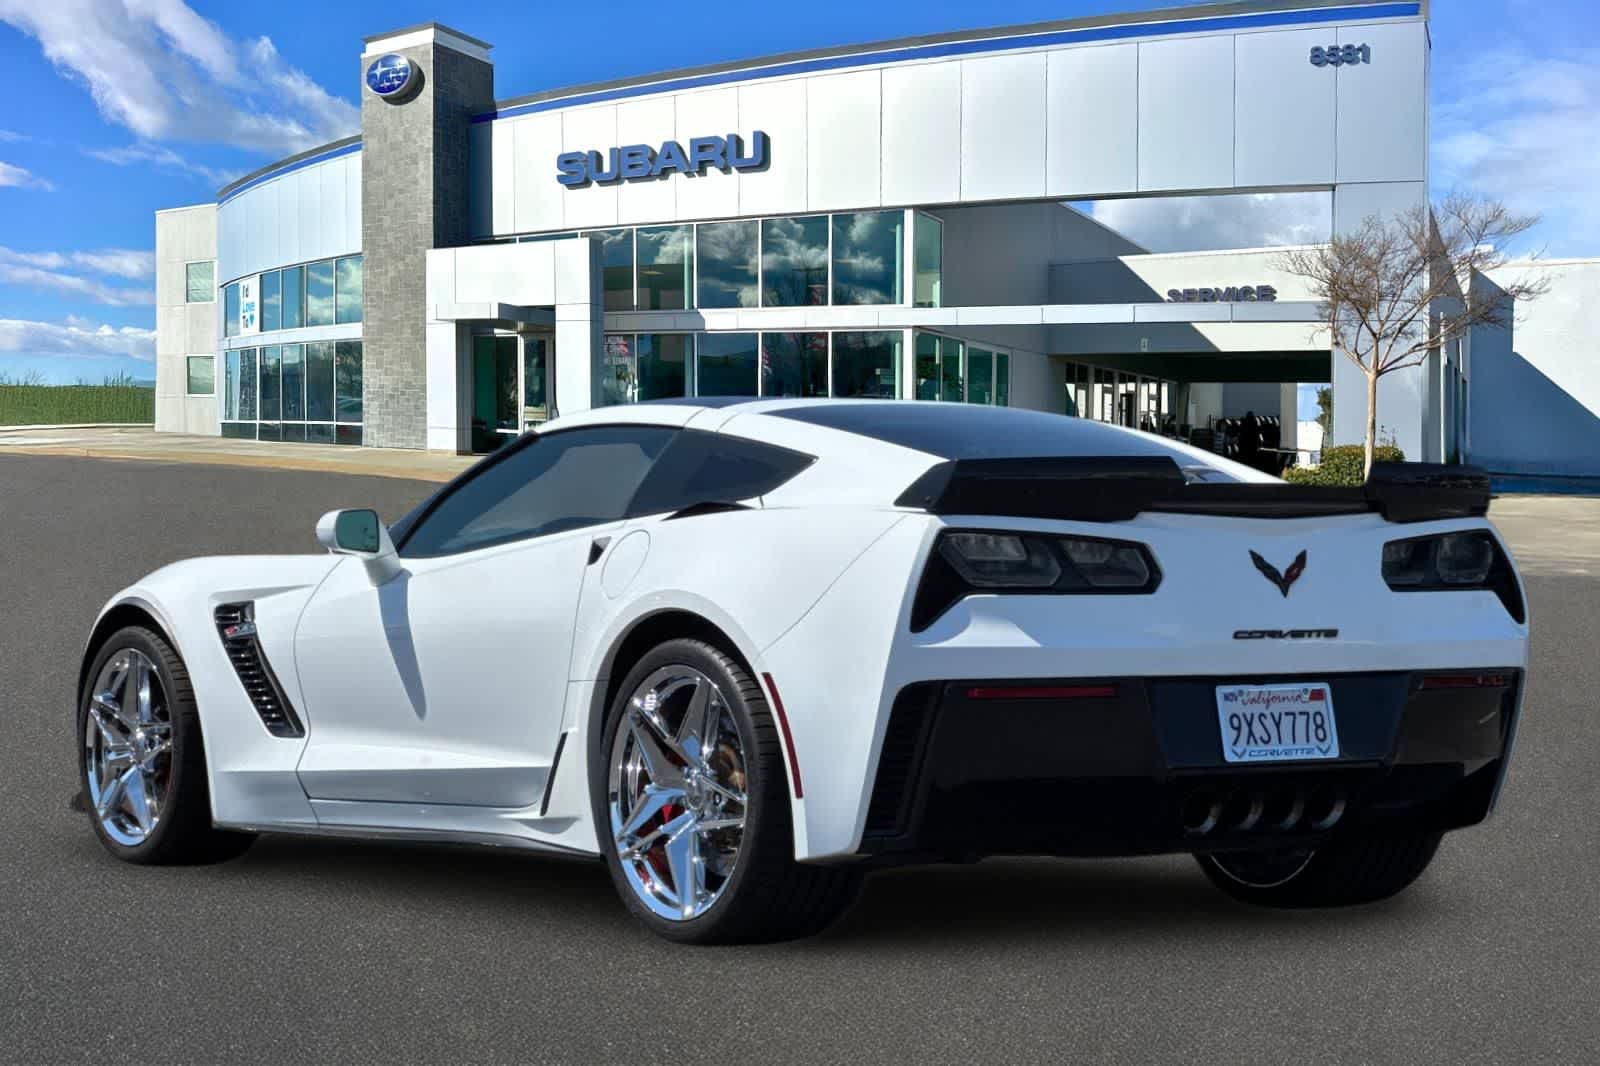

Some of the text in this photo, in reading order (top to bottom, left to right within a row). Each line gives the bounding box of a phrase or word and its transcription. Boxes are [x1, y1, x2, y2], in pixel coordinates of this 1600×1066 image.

[556, 130, 771, 190] SUBARU
[1167, 285, 1277, 302] SERVICE
[1233, 629, 1338, 640] CORVETTE
[1241, 689, 1310, 710] California
[1229, 712, 1327, 746] 9XSY778
[1248, 748, 1316, 757] CORVETTE
